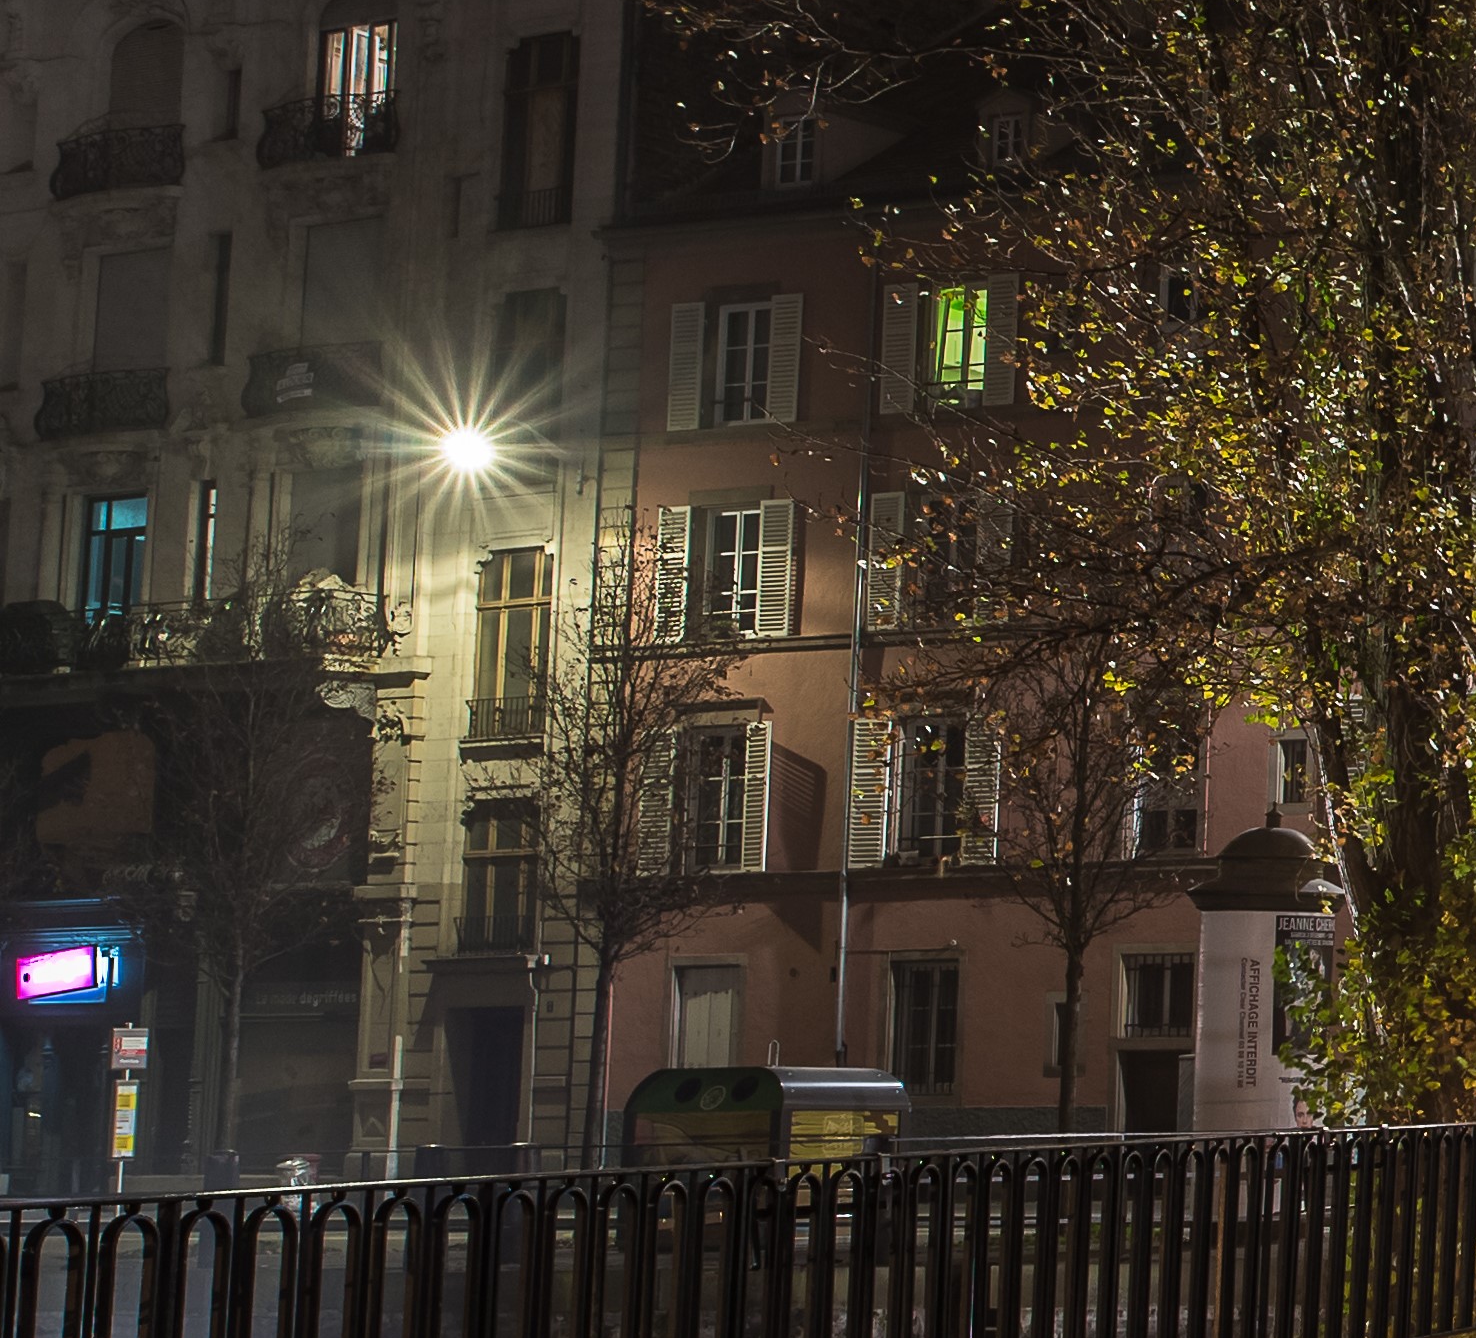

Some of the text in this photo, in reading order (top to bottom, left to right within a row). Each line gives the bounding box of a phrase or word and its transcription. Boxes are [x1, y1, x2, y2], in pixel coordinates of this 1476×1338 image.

[1278, 917, 1315, 931] JEANNE
[1245, 959, 1261, 1087] AFFICHAGE INTERDIT
